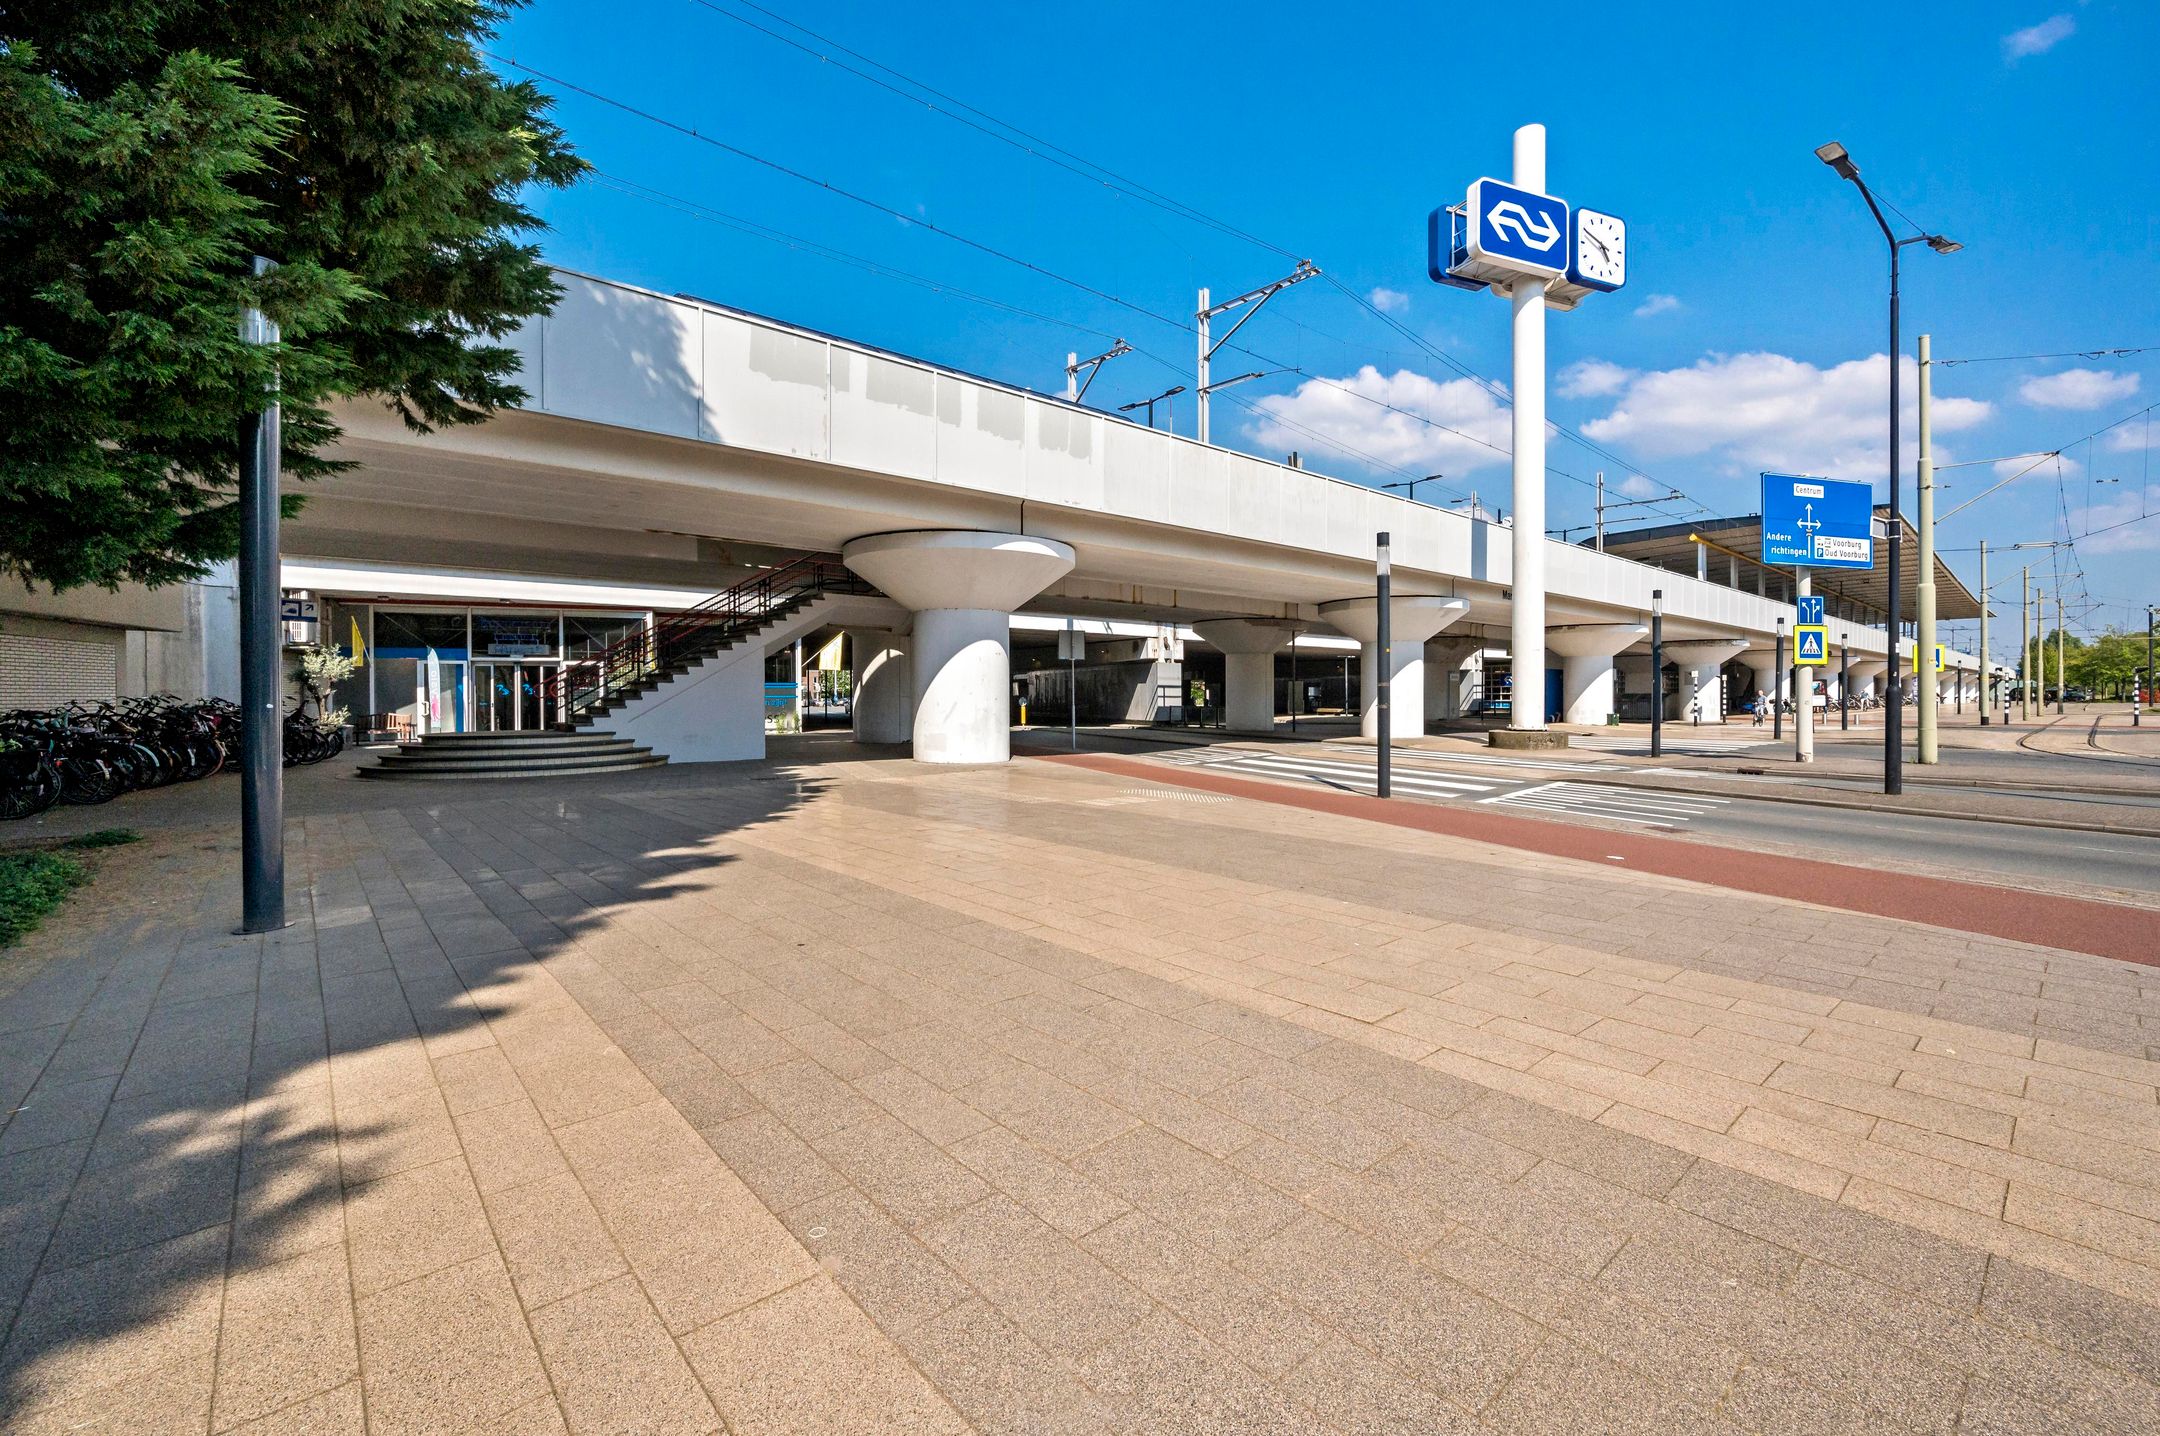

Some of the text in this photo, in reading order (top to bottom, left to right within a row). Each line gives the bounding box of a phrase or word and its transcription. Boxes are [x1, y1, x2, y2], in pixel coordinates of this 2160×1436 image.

[1796, 485, 1823, 495] Centrum
[1766, 532, 1792, 541] Andere
[1832, 539, 1862, 550] Voorburg
[1771, 546, 1807, 557] richtingen
[1825, 549, 1837, 557] Oud
[1839, 550, 1868, 560] Voorburg
